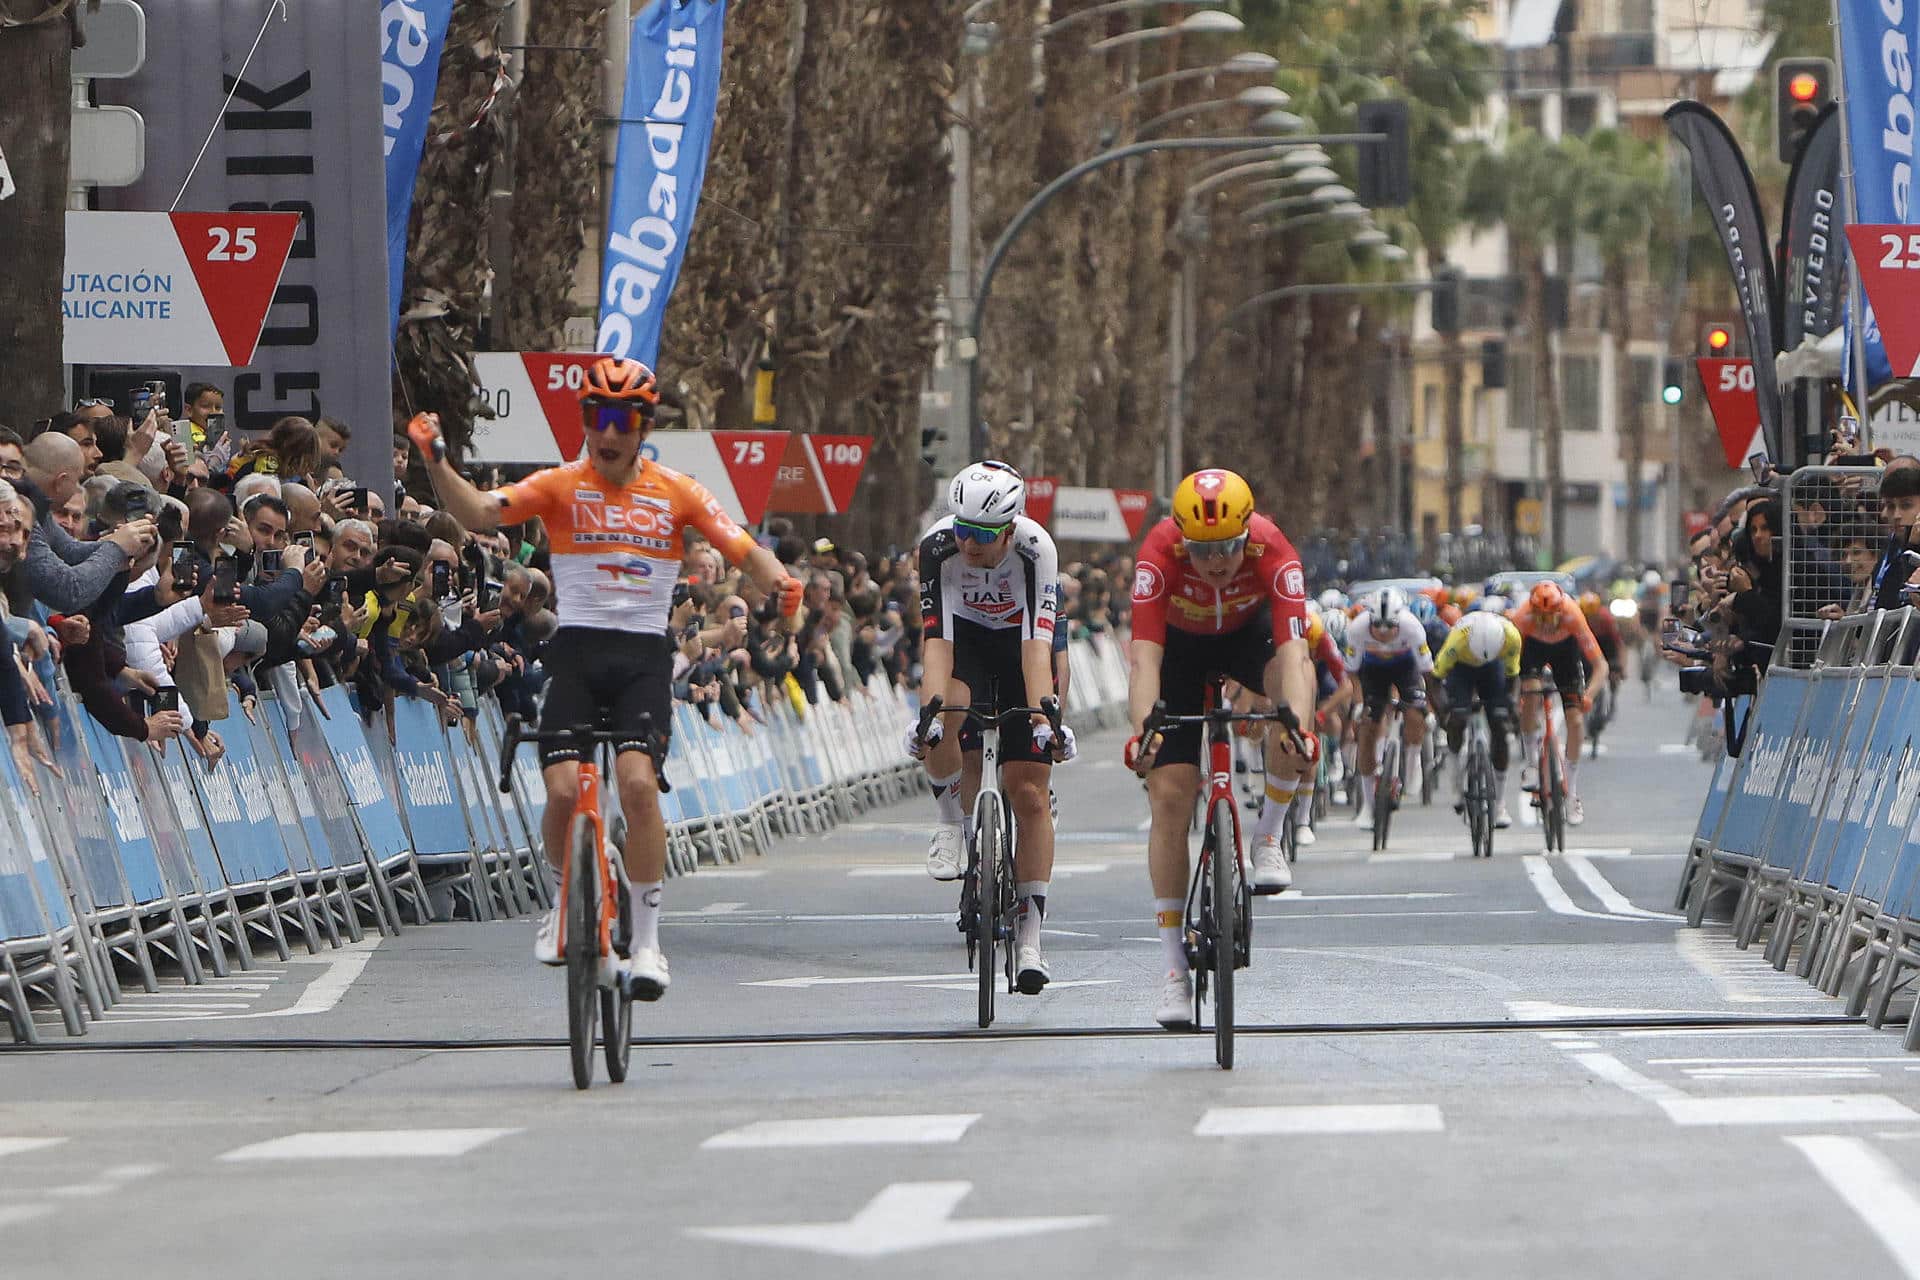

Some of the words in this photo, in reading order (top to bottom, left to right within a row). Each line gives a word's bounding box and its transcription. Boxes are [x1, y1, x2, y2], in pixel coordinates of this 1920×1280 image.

[206, 227, 257, 262] 25
[1879, 234, 1920, 269] 25
[547, 363, 585, 391] 50
[1719, 364, 1756, 392] 50
[732, 440, 766, 465] 75
[821, 443, 863, 465] 100
[571, 503, 674, 535] INEOS
[962, 591, 1013, 604] UAE
